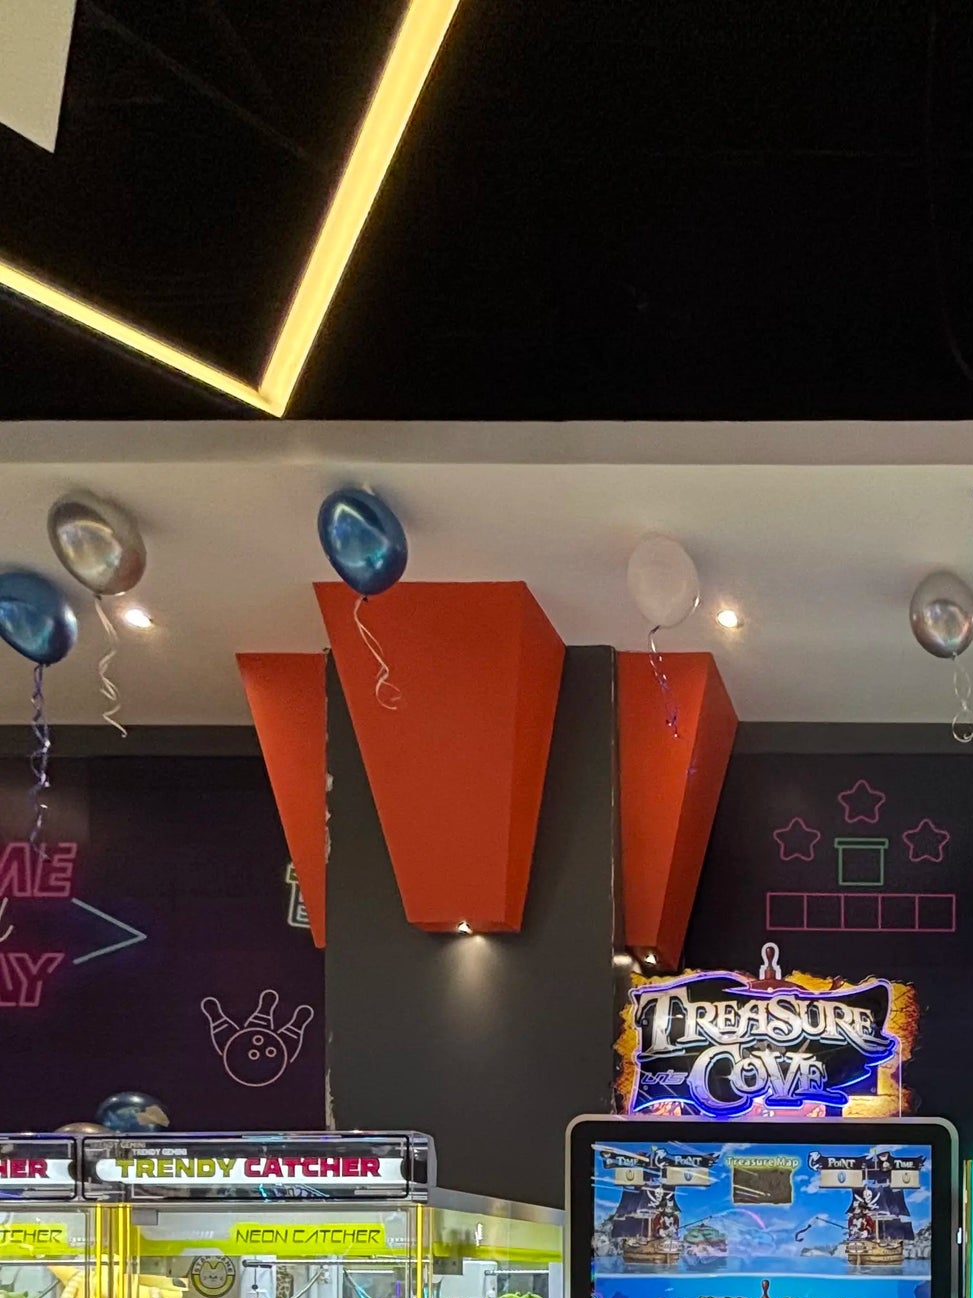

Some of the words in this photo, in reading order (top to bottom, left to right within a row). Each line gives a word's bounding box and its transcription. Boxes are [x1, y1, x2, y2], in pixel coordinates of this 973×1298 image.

[635, 985, 893, 1056] TREASURE
[689, 1044, 847, 1113] COVE
[116, 1158, 237, 1178] TRENDY
[244, 1157, 381, 1177] CATCHER
[236, 1230, 288, 1243] NEON
